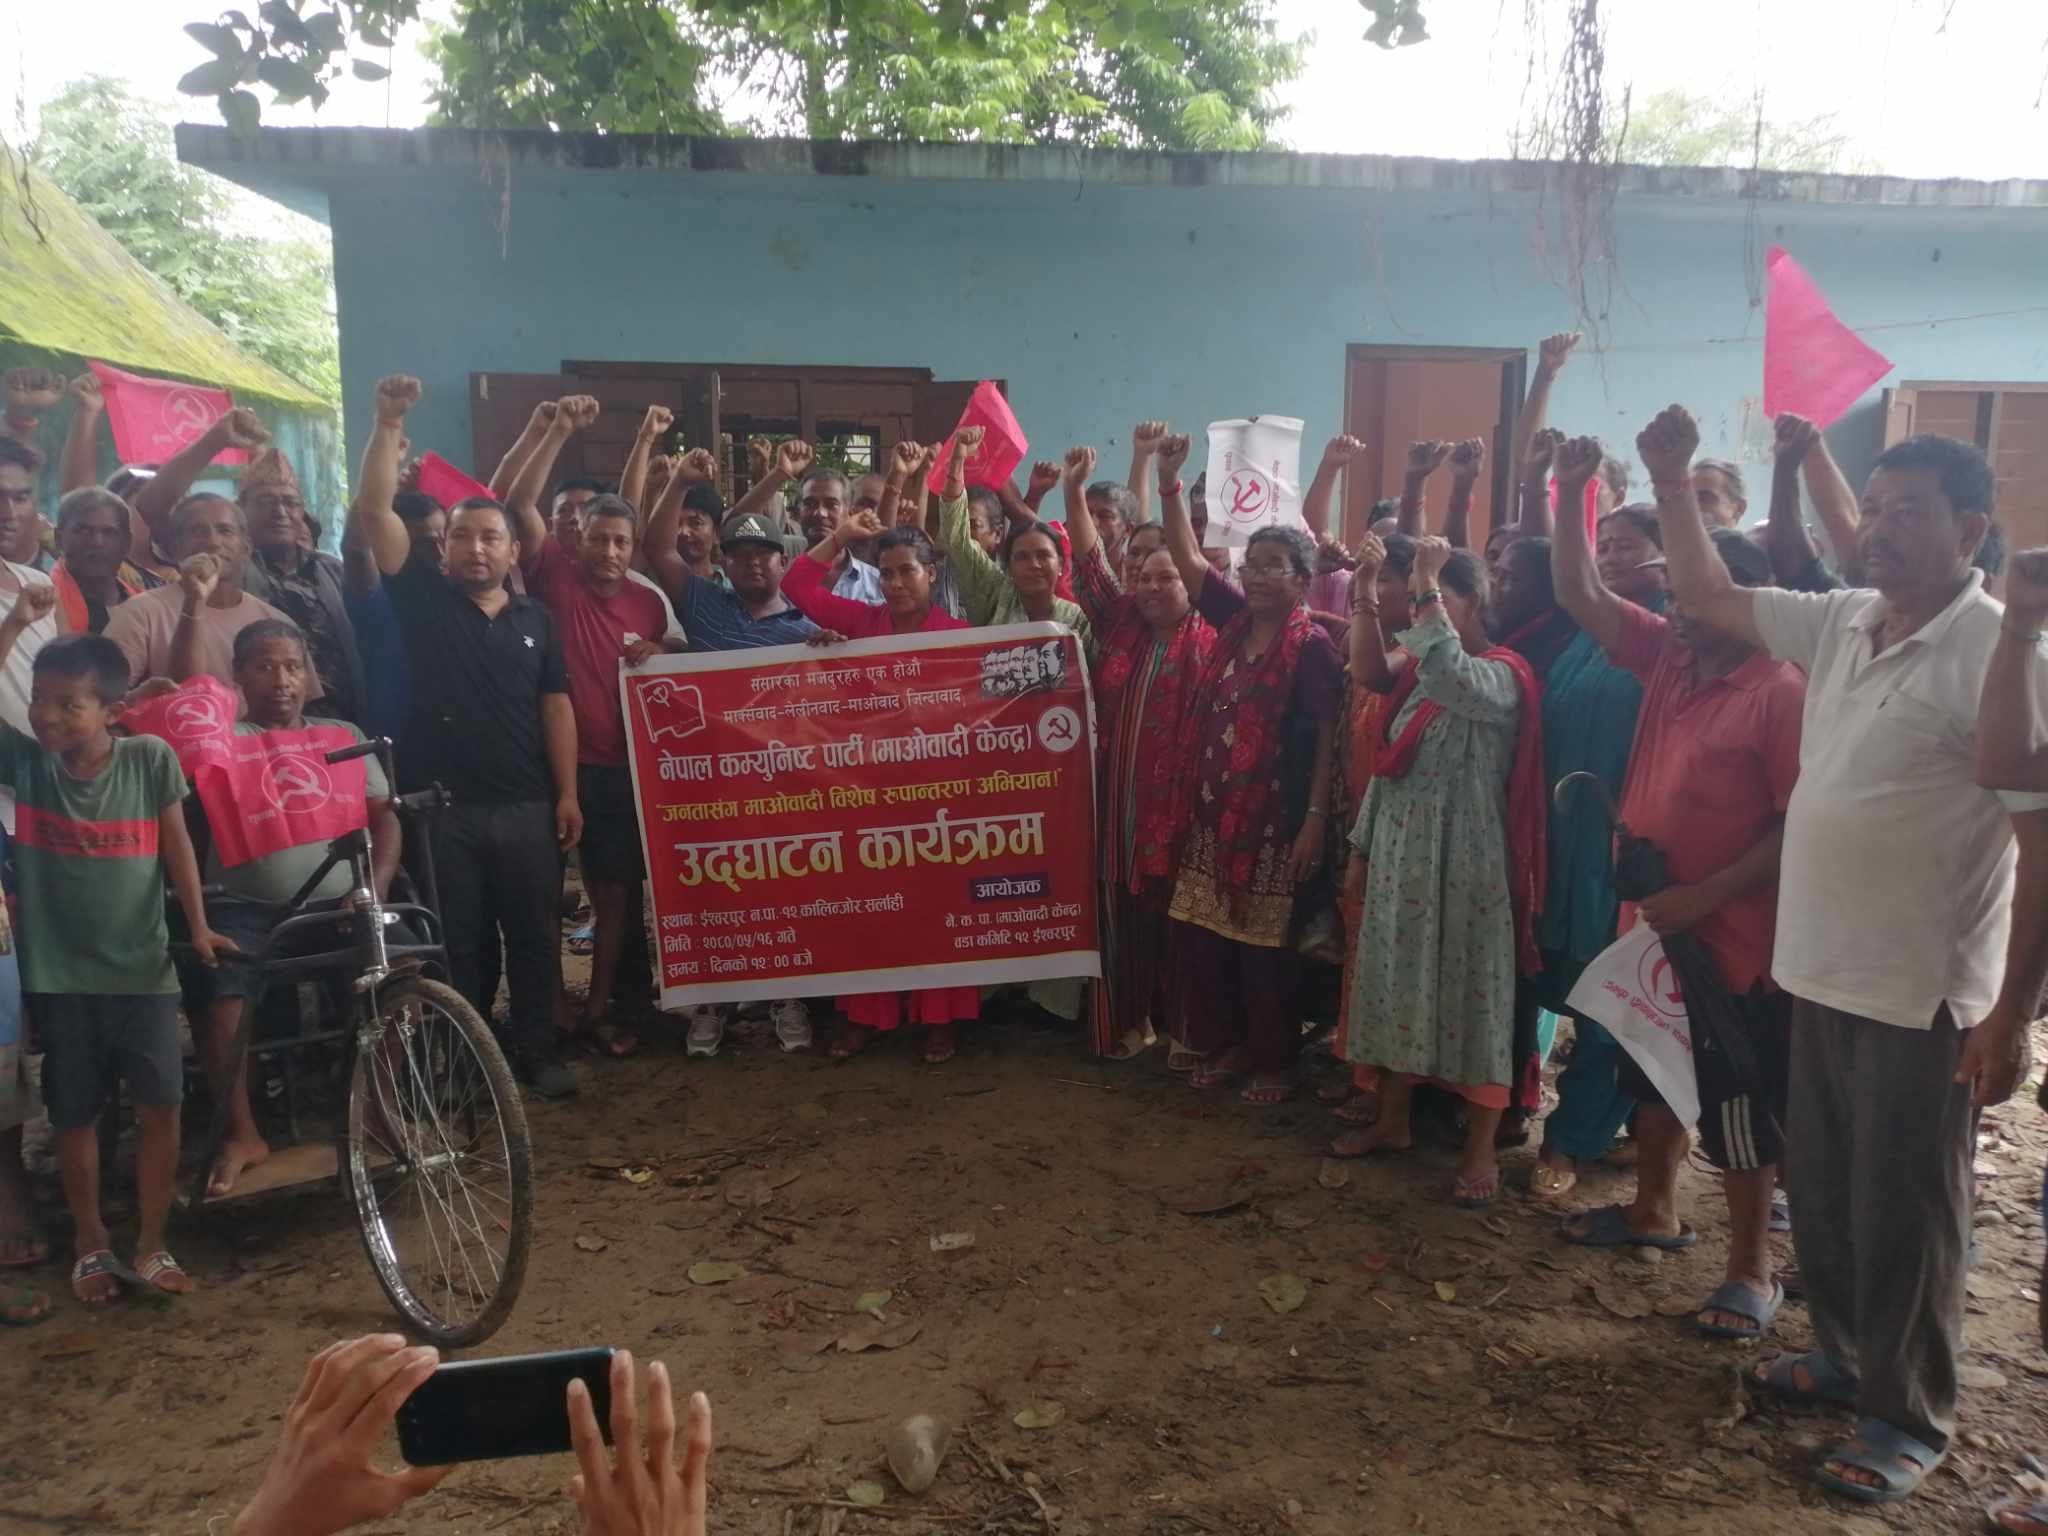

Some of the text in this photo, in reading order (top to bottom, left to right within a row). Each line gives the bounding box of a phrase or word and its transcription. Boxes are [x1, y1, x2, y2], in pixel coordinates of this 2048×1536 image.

[866, 665, 887, 685] एक
[657, 720, 1032, 782] नेपाल कम्युनिष्ट पार्टी (माओवादी केन्द्र)
[744, 789, 824, 816] माओवादी
[829, 785, 876, 808] विशेष
[856, 807, 1045, 870] कार्यक्रम
[975, 878, 1041, 898] आयोजक
[664, 934, 691, 954] मिति
[777, 927, 797, 945] गते
[954, 935, 974, 949] वडा
[1015, 931, 1029, 943] १२
[667, 959, 699, 978] समय
[710, 956, 749, 974] दिनको
[792, 949, 813, 967] बजे
